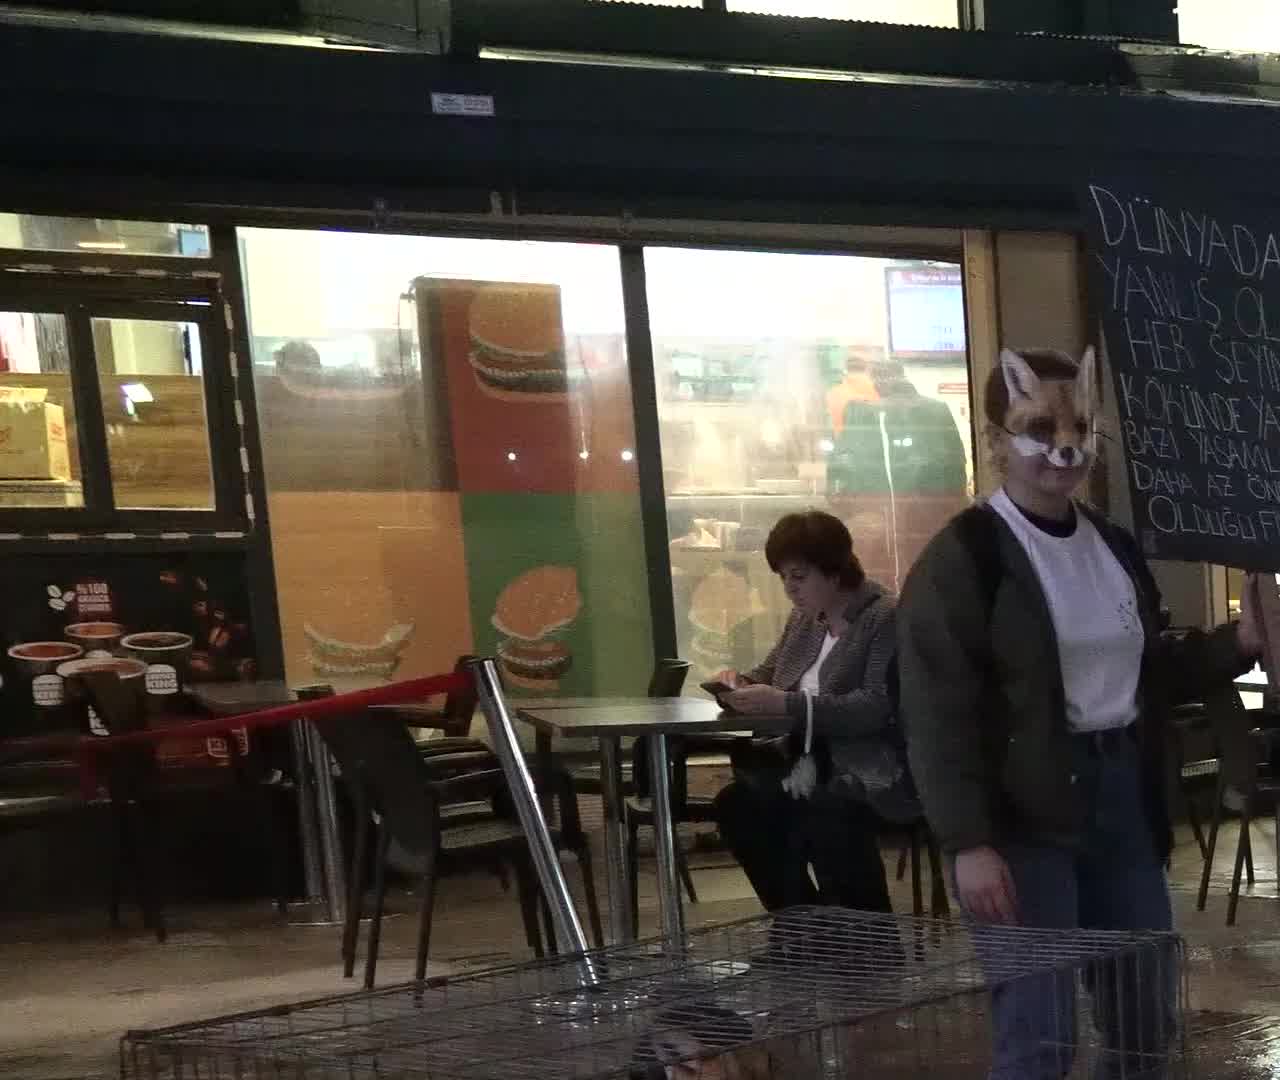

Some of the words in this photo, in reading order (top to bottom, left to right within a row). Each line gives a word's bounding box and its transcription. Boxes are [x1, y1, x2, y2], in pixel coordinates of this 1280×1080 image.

[1124, 317, 1196, 374] HER
[1130, 459, 1200, 497] DAHA
[1207, 472, 1241, 497] AZ
